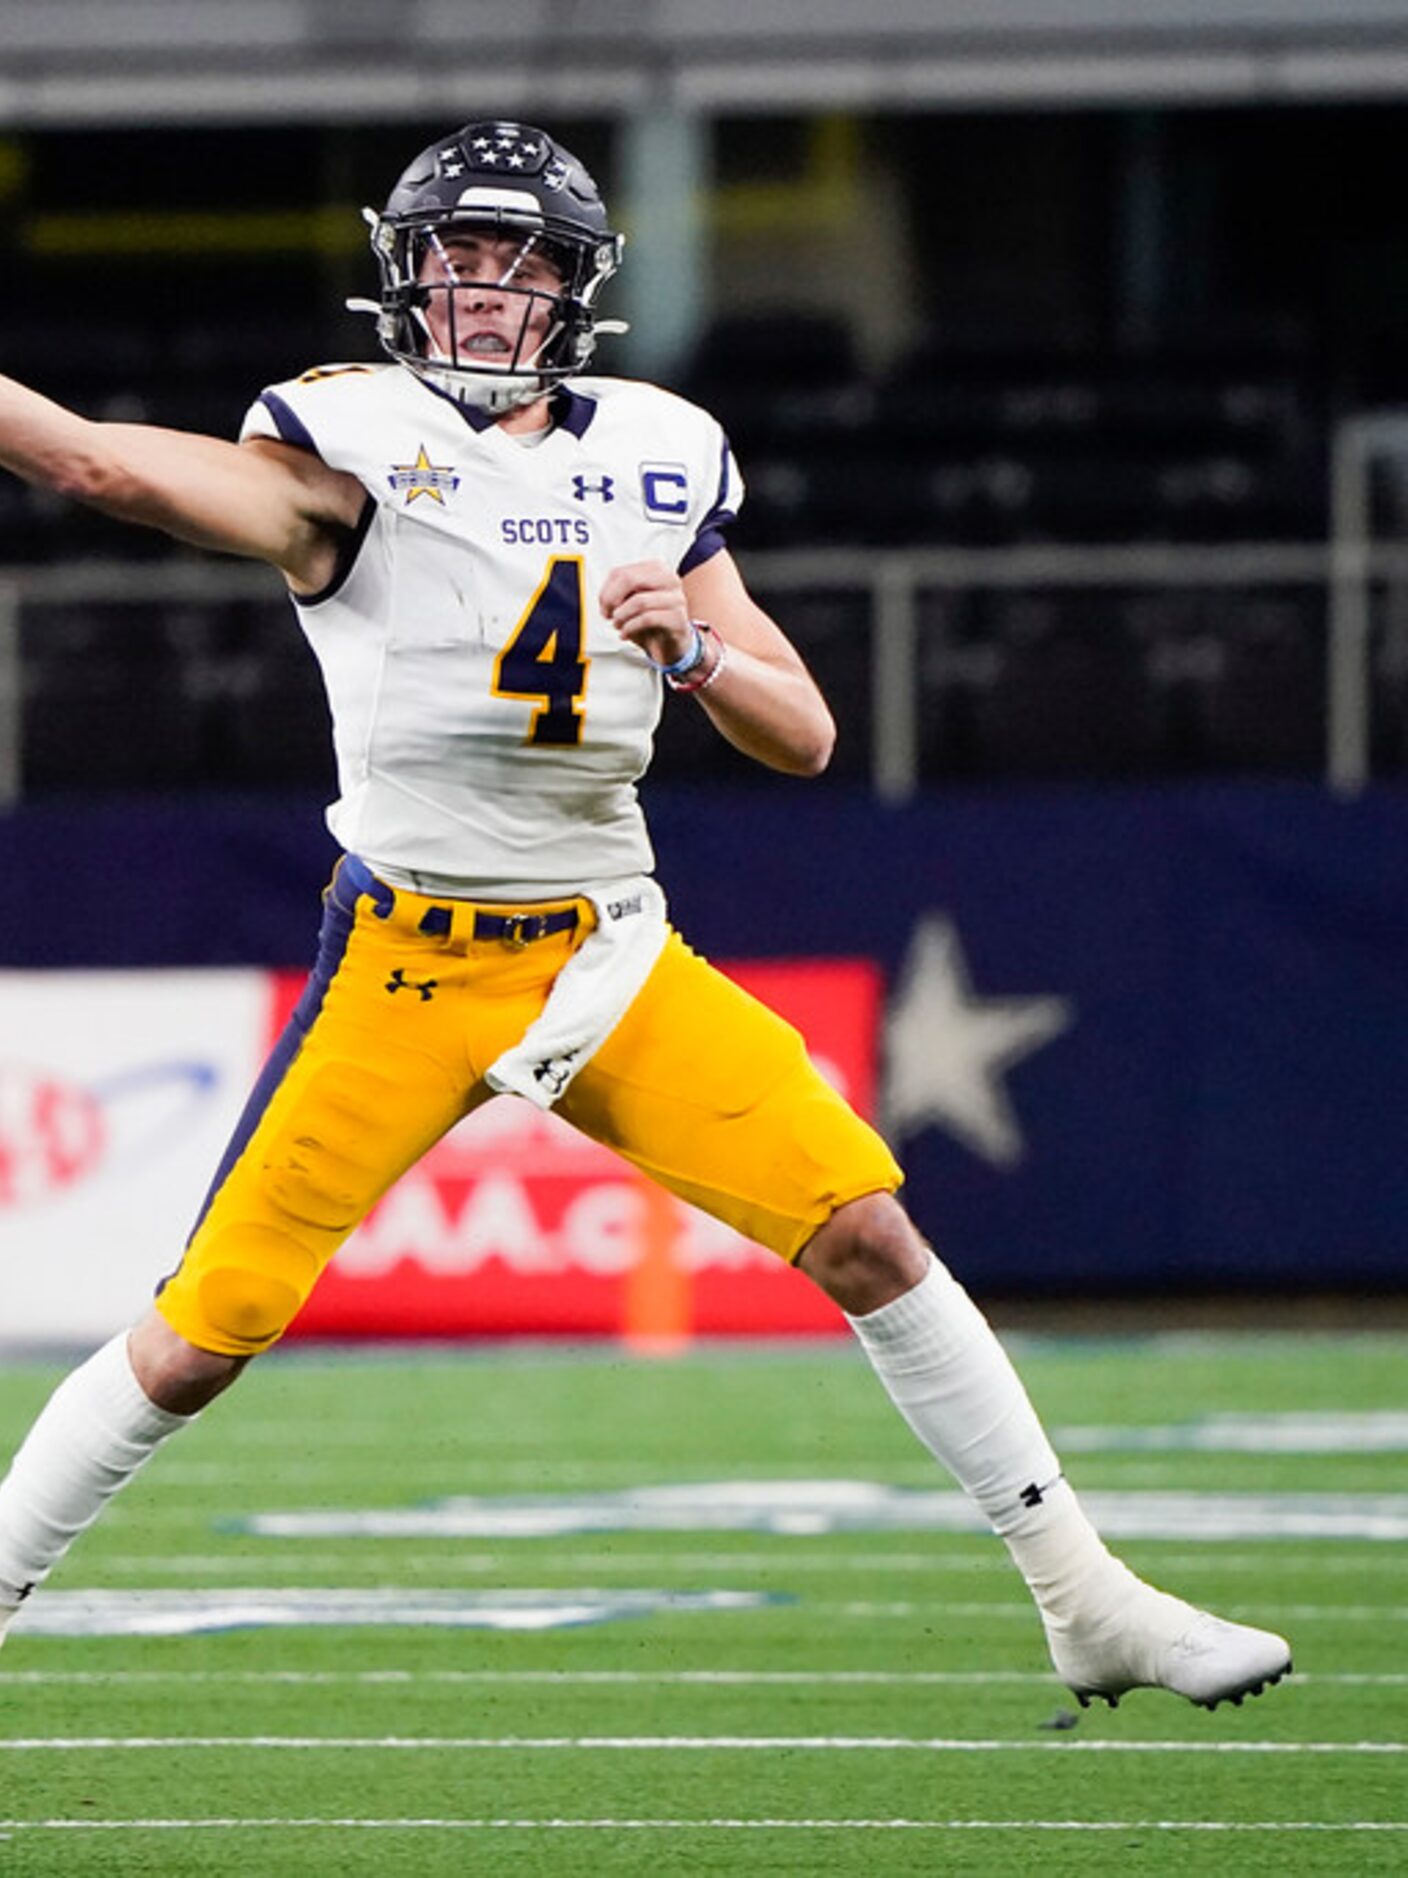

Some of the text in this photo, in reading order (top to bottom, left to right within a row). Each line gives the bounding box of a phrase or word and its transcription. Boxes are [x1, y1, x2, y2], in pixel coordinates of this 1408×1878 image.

[643, 472, 687, 513] C
[502, 519, 589, 544] SCOTS
[489, 554, 591, 746] 4
